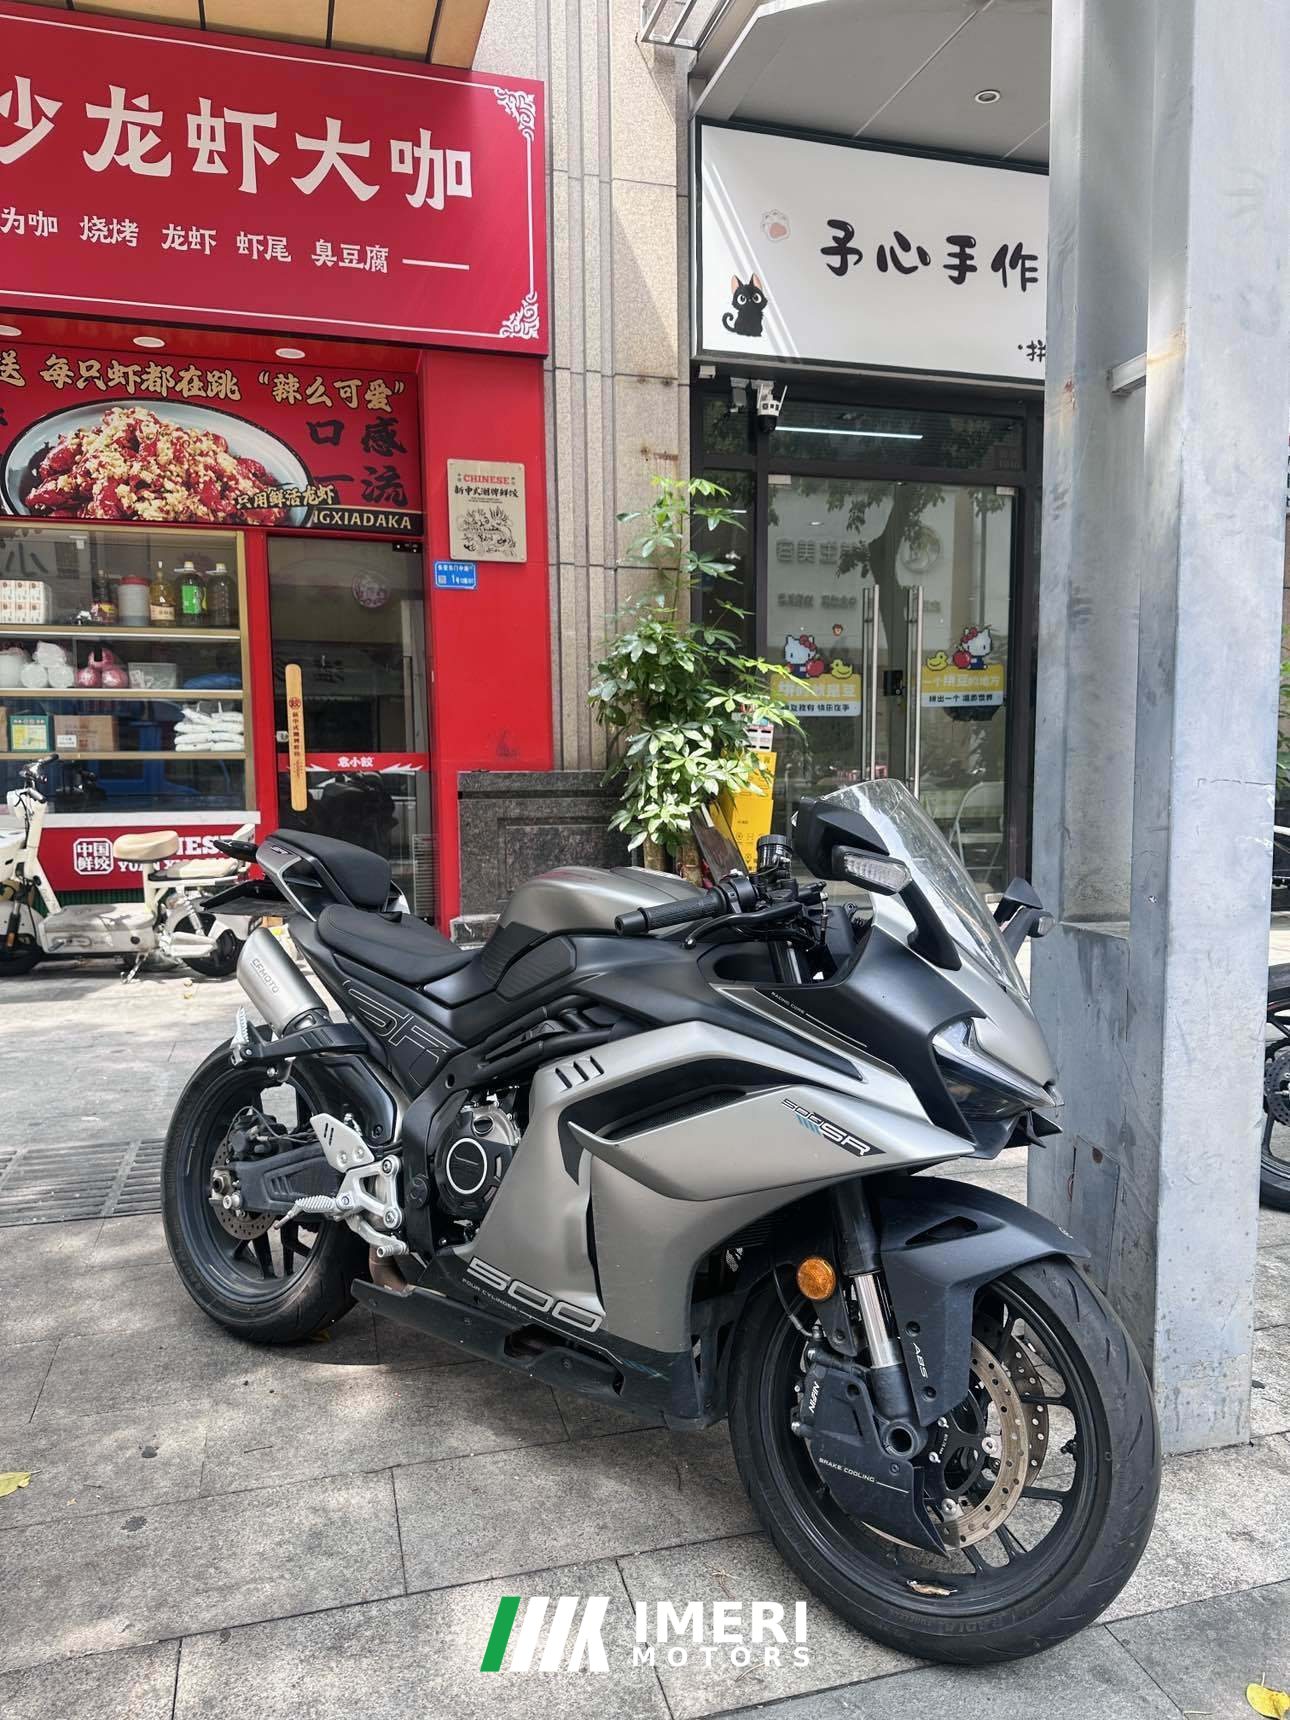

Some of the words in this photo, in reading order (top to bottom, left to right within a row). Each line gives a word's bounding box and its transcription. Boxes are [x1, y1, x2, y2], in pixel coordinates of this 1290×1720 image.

[79, 215, 139, 248] 烧烤
[162, 224, 216, 254] 龙虾
[237, 232, 292, 263] 虾尾
[312, 239, 388, 273] 臭豆腐
[820, 219, 1039, 292] 予心手作
[39, 353, 240, 401] 每只虾都在跳
[306, 416, 407, 456] 口感
[236, 484, 334, 508] 只用鲜活龙虾
[463, 474, 509, 485] CHINESE
[77, 842, 110, 857] 中国
[461, 1277, 481, 1293] FOUR
[481, 1289, 518, 1312] CYLINDER
[467, 1257, 602, 1333] 500
[912, 1342, 928, 1379] ABS
[818, 1457, 842, 1472] BRAKE
[843, 1466, 876, 1483] COOLING
